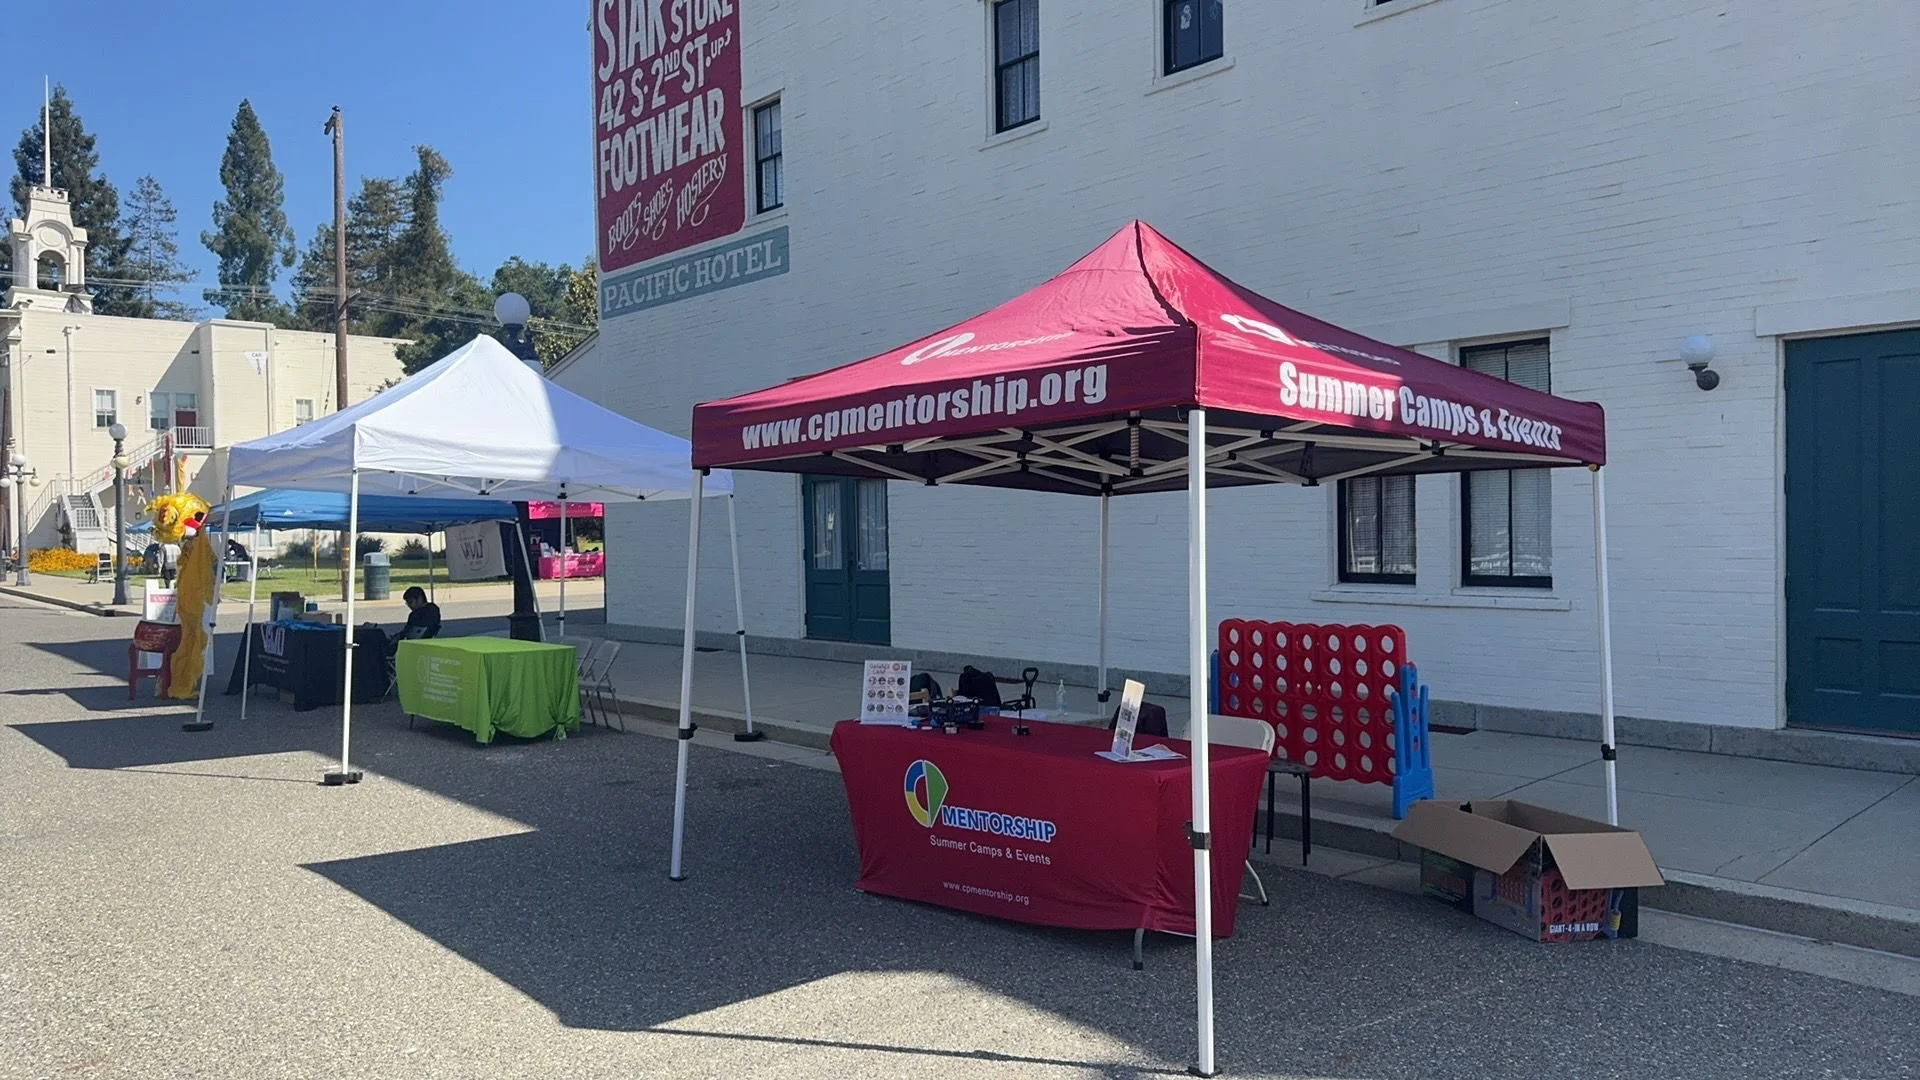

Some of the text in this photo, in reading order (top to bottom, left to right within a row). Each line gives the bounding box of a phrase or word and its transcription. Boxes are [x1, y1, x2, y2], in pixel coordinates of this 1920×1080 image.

[597, 0, 667, 82] STAR
[599, 78, 626, 132] 42
[600, 87, 726, 199] FOOTWEAR
[608, 153, 728, 256] BOOTS SHOES HOSIERY
[603, 239, 782, 313] PACIFIC HOTEL
[742, 363, 1108, 451] www.cpmentorship.org
[1279, 361, 1563, 452] Summer Camps & Events
[930, 834, 1051, 865] Summer Camps & Events
[941, 804, 1056, 843] MENTORSHIP
[943, 880, 1030, 906] www.cpmentorship.org
